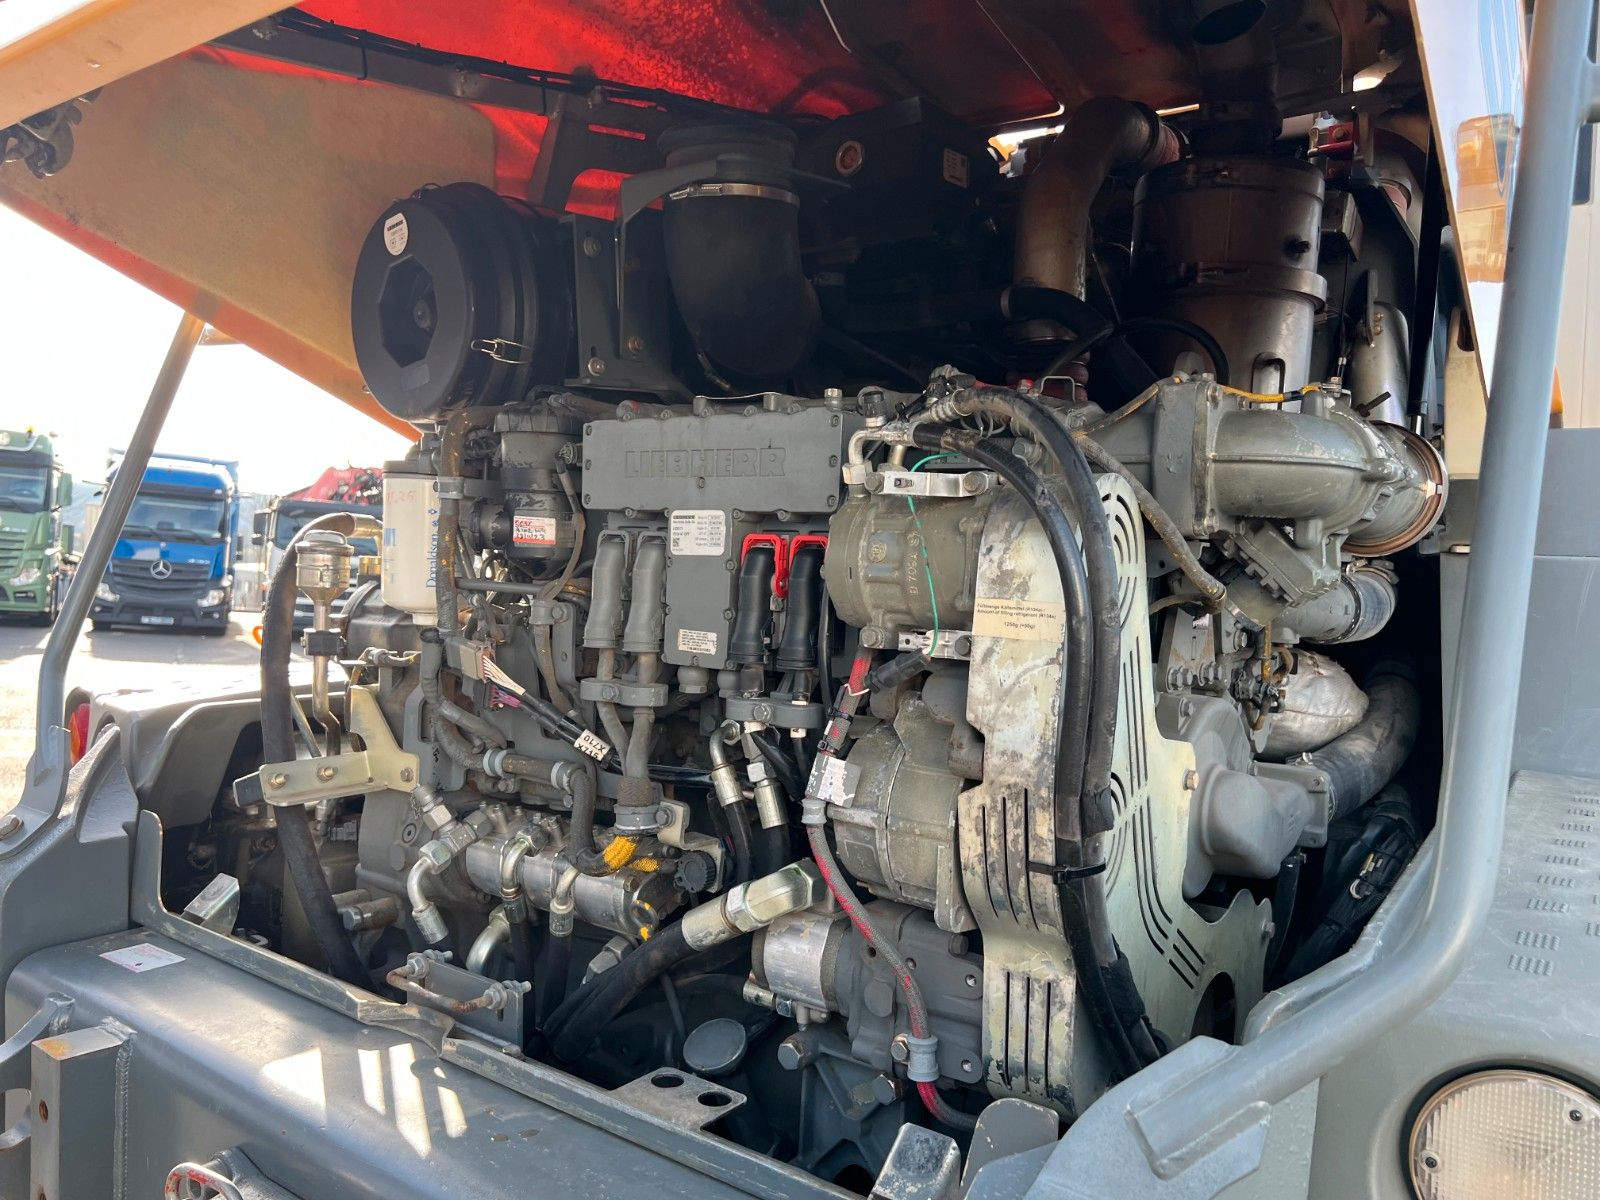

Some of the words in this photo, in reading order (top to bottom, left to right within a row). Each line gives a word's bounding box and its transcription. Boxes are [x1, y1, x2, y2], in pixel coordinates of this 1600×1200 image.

[625, 448, 786, 477] LIEBHERR
[426, 533, 439, 588] Donaldson
[583, 734, 606, 753] X710
